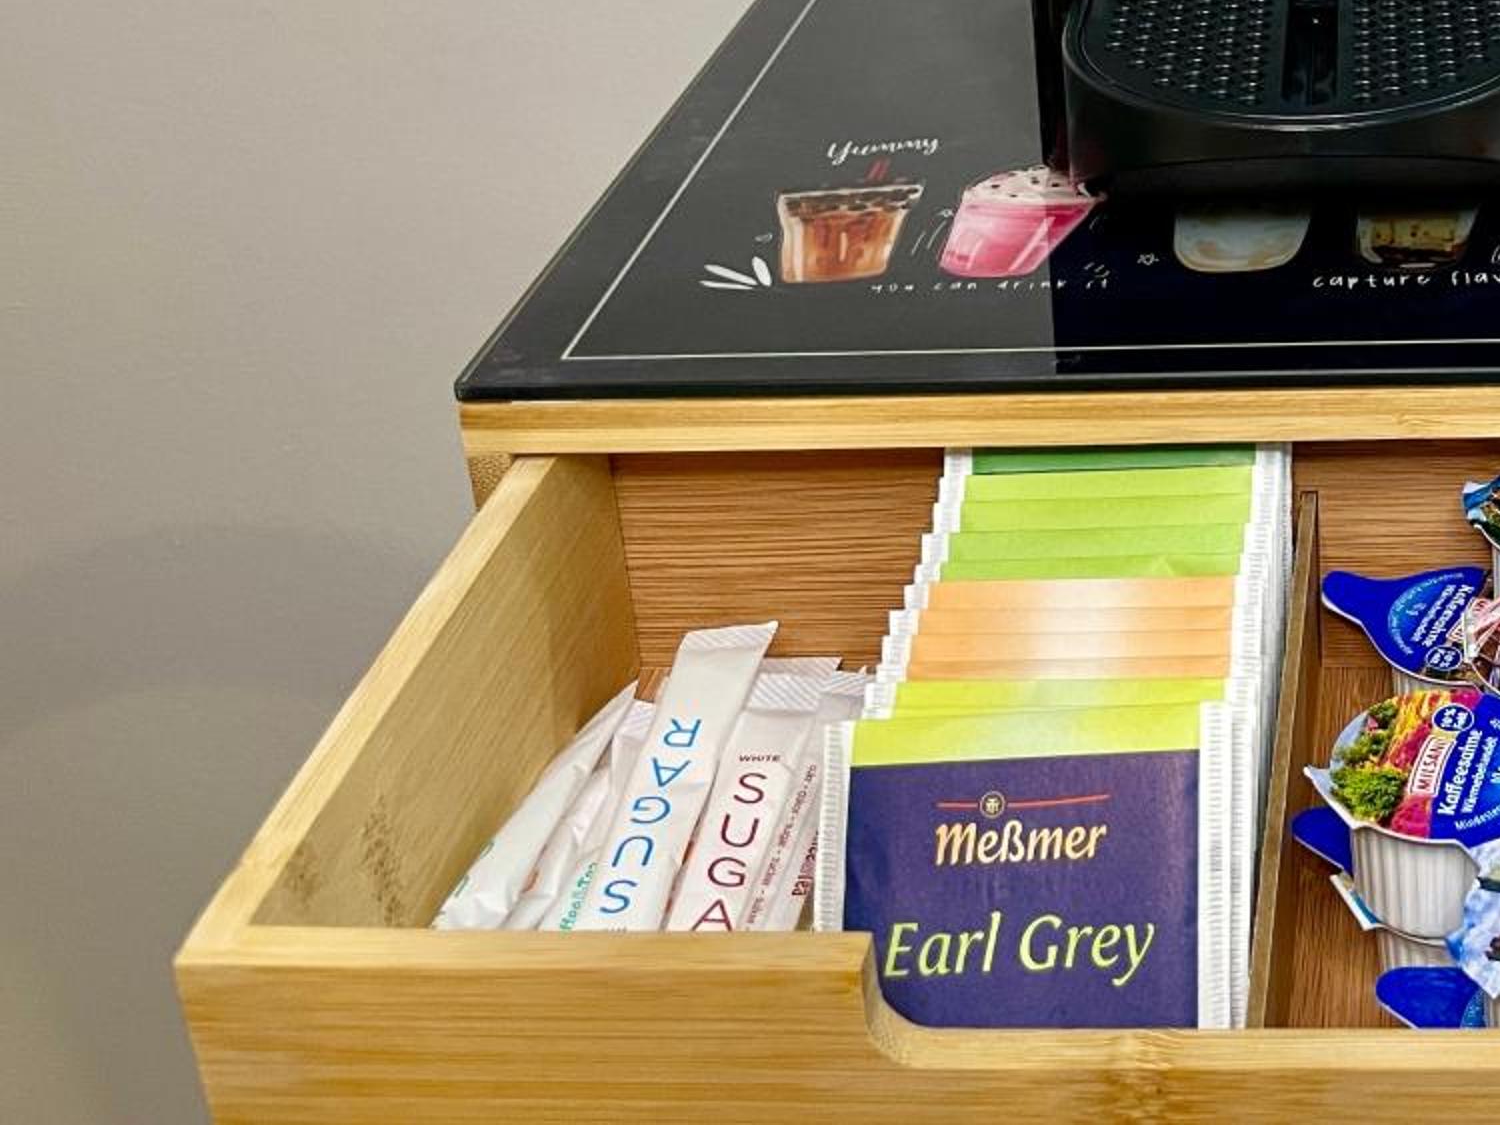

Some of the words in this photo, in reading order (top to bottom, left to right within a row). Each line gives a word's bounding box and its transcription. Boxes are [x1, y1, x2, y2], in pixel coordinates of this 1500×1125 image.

[827, 138, 939, 166] Yummy
[871, 283, 914, 294] you
[933, 281, 977, 291] can
[998, 279, 1066, 291] drink
[1312, 274, 1431, 289] capture
[738, 753, 781, 763] WHITE
[1416, 736, 1450, 791] MILSANI
[1437, 729, 1483, 815] Kaffeesahne
[1461, 736, 1498, 813] Wärmebehandelt
[690, 772, 770, 932] SUGA
[934, 819, 1108, 867] Meßmer
[884, 909, 1002, 978] Earl
[1018, 913, 1156, 987] Grey
